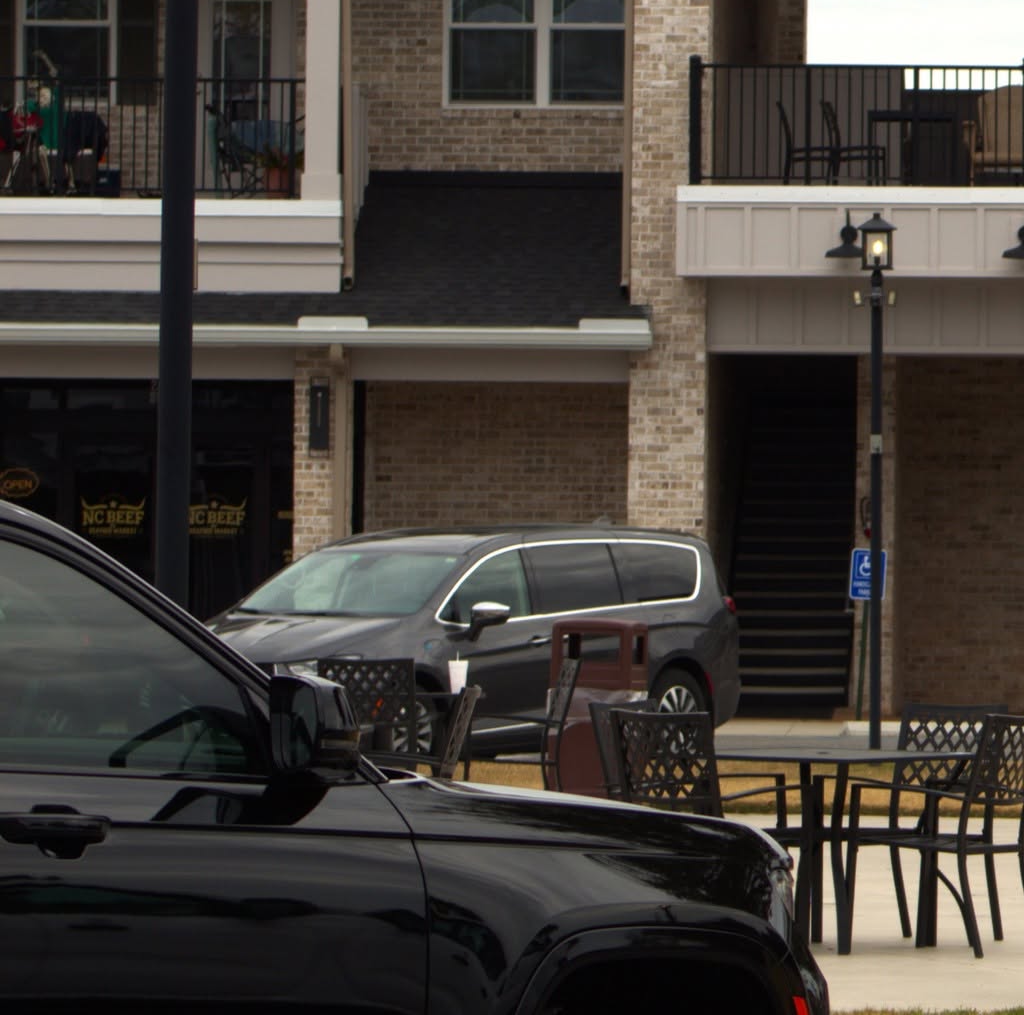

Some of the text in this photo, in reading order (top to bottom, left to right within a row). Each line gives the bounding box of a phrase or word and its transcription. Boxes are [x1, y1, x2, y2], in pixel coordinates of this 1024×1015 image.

[3, 479, 33, 489] OPEN
[82, 510, 145, 526] NC BEEF
[207, 511, 246, 525] BEEF
